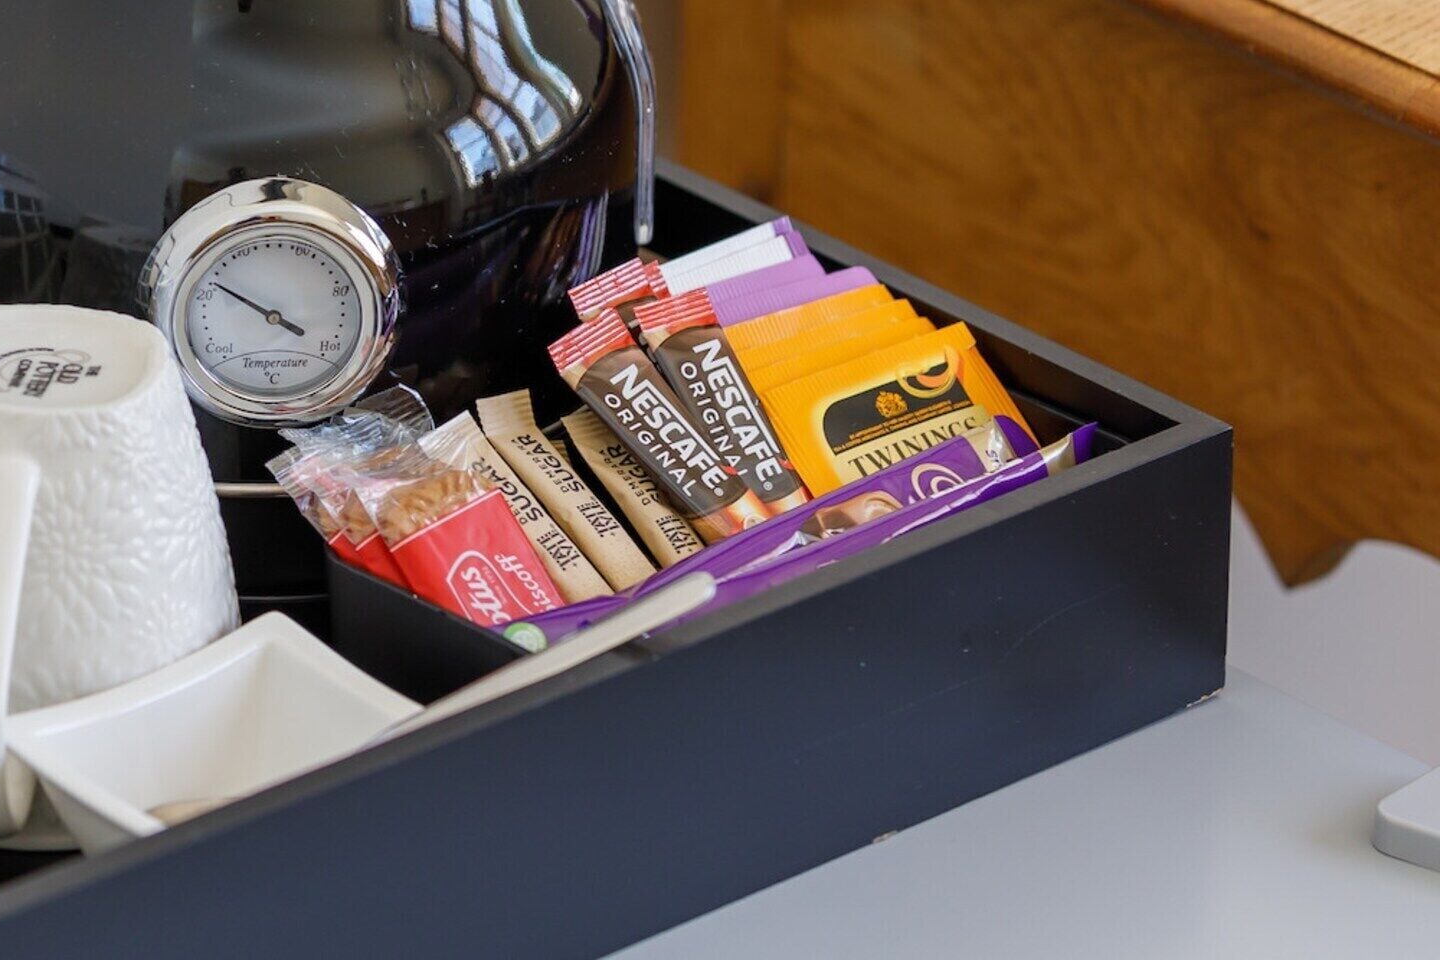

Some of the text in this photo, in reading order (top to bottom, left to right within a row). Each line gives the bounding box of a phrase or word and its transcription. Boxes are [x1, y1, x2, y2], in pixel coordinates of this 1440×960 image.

[332, 285, 350, 297] 80
[205, 342, 233, 354] Cool
[320, 340, 341, 352] Hot
[242, 357, 309, 370] Temperature
[604, 393, 697, 497] ORIGINAL
[517, 434, 586, 493] SUGAR
[461, 567, 512, 624] otus
